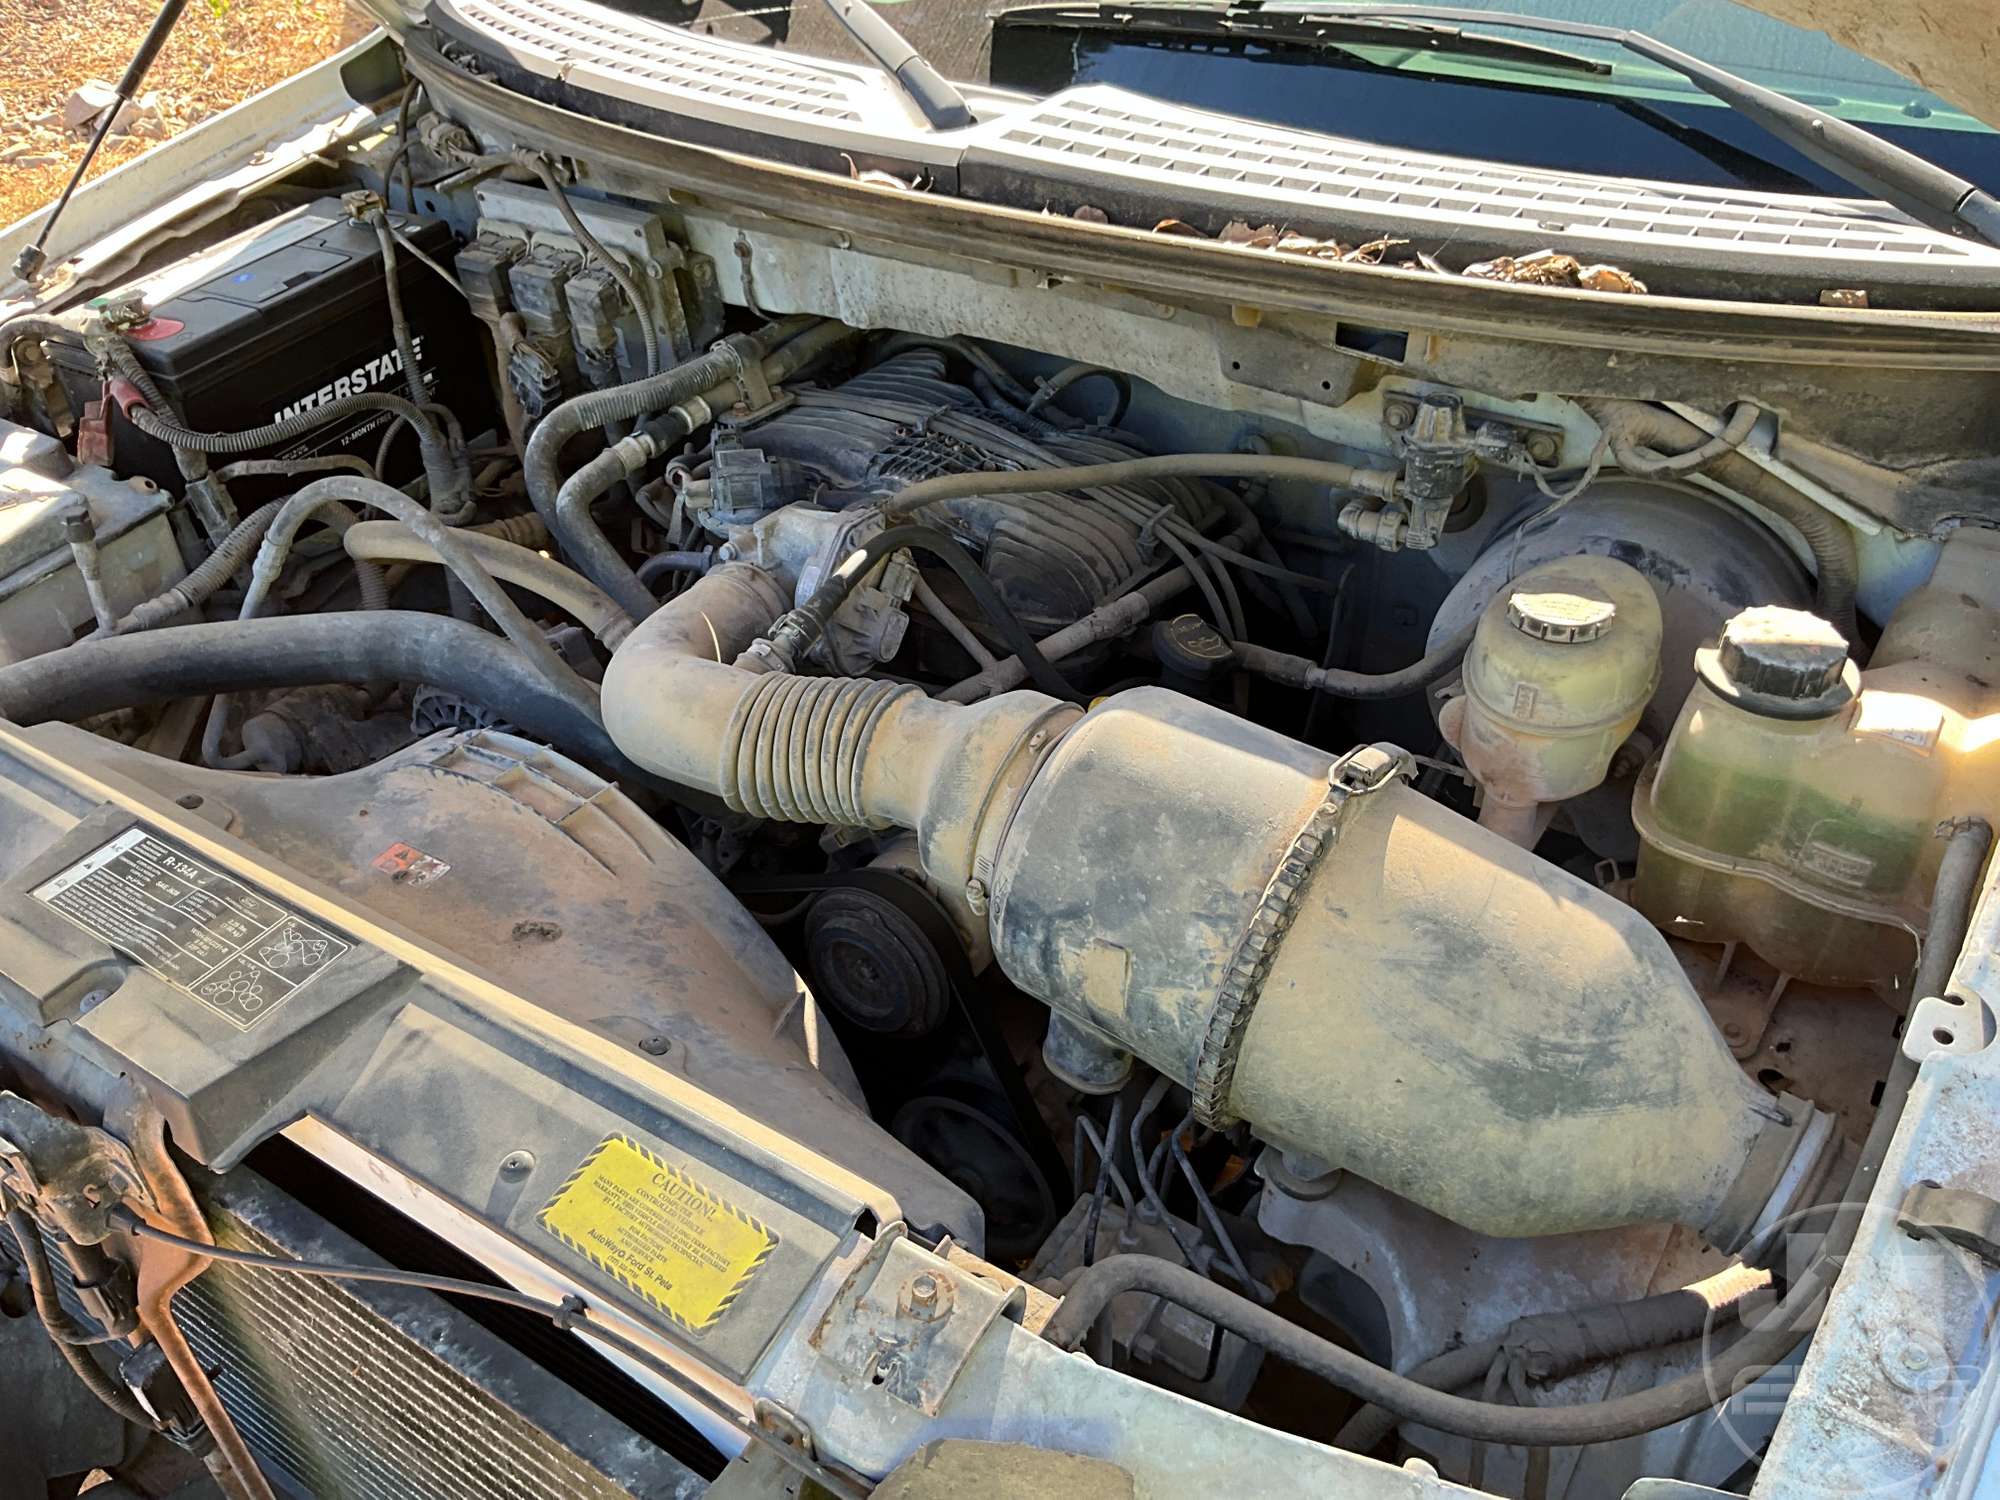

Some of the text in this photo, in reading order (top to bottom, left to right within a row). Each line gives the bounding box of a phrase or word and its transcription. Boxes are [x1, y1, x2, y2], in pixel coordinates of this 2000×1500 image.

[340, 420, 376, 446] 12-MONTH
[163, 856, 199, 879] R-134A
[634, 1187, 678, 1218] CONTROLLED
[649, 1171, 718, 1220] CAUTION!
[624, 1253, 646, 1271] Ford
[654, 1274, 674, 1290] Pete
